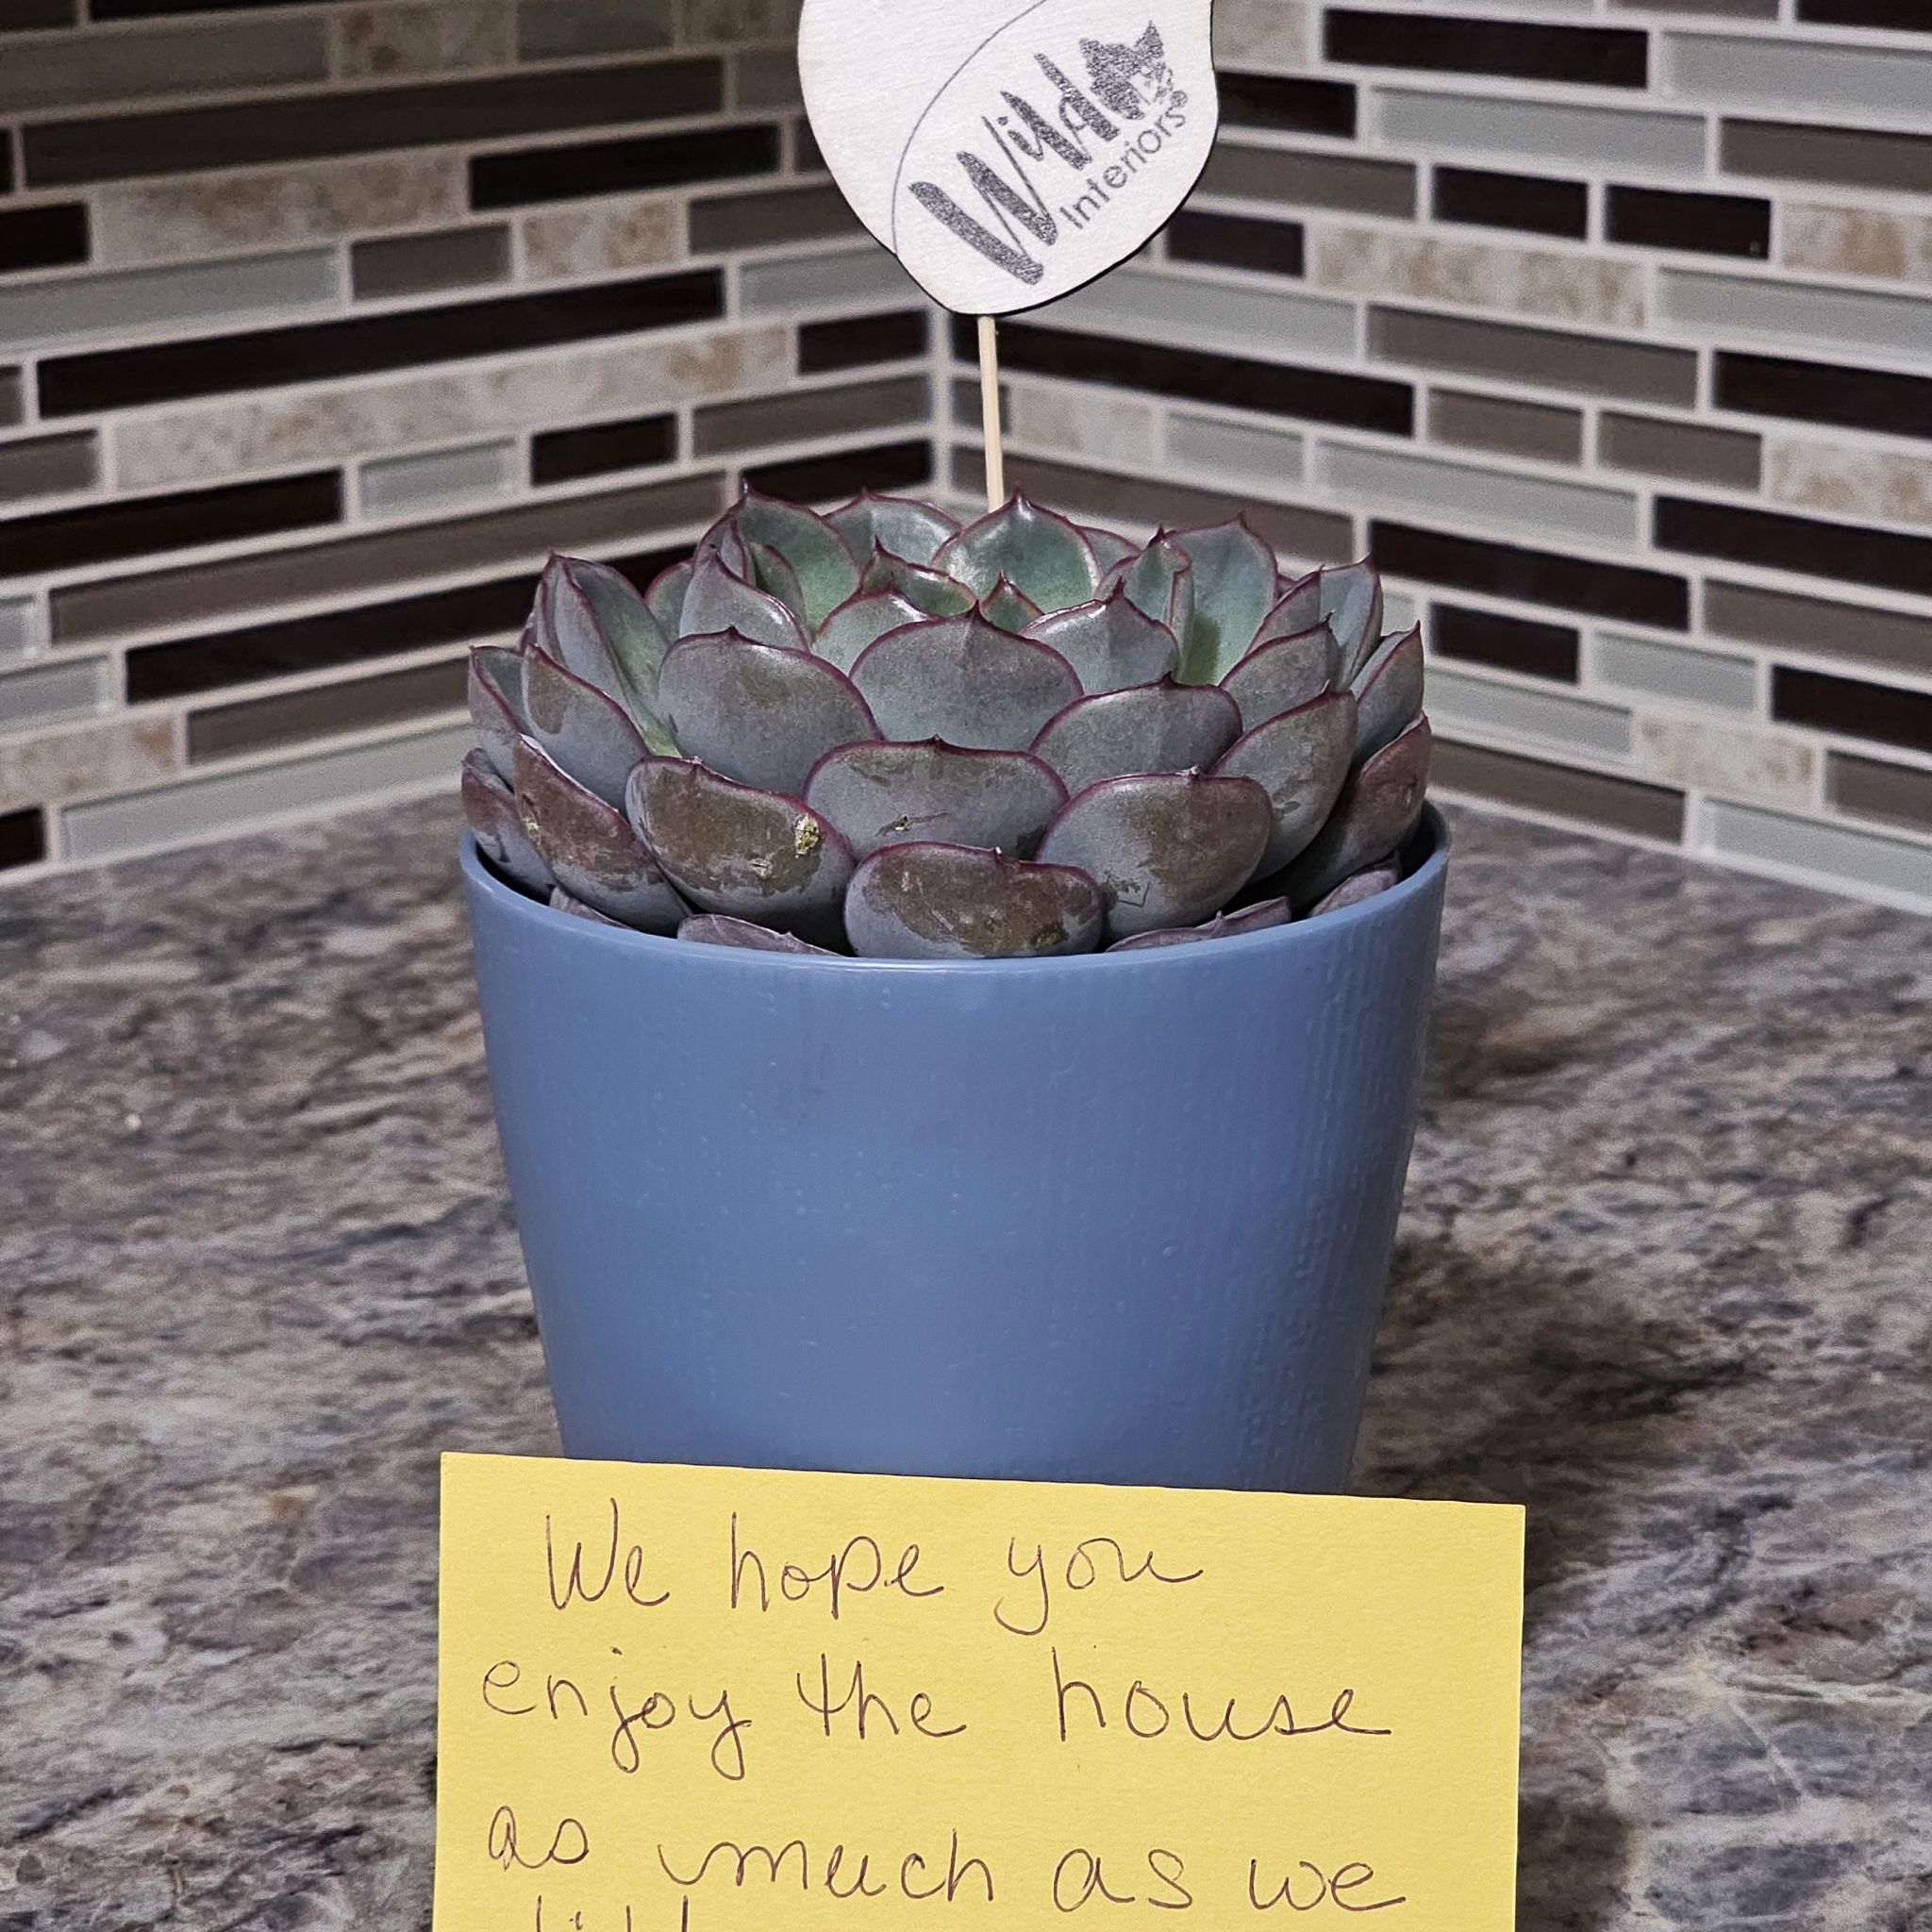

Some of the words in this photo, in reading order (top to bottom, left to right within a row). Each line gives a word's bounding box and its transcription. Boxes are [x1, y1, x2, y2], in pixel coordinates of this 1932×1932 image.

[908, 52, 1121, 286] Wild
[545, 1496, 671, 1611] We
[730, 1511, 945, 1621] hope
[992, 1536, 1205, 1637] you
[482, 1646, 753, 1781] enjoy
[796, 1652, 968, 1740] the
[1051, 1645, 1392, 1742] house
[488, 1805, 590, 1873] as
[657, 1827, 994, 1903] much
[1053, 1848, 1193, 1913] as
[1248, 1857, 1407, 1912] we
